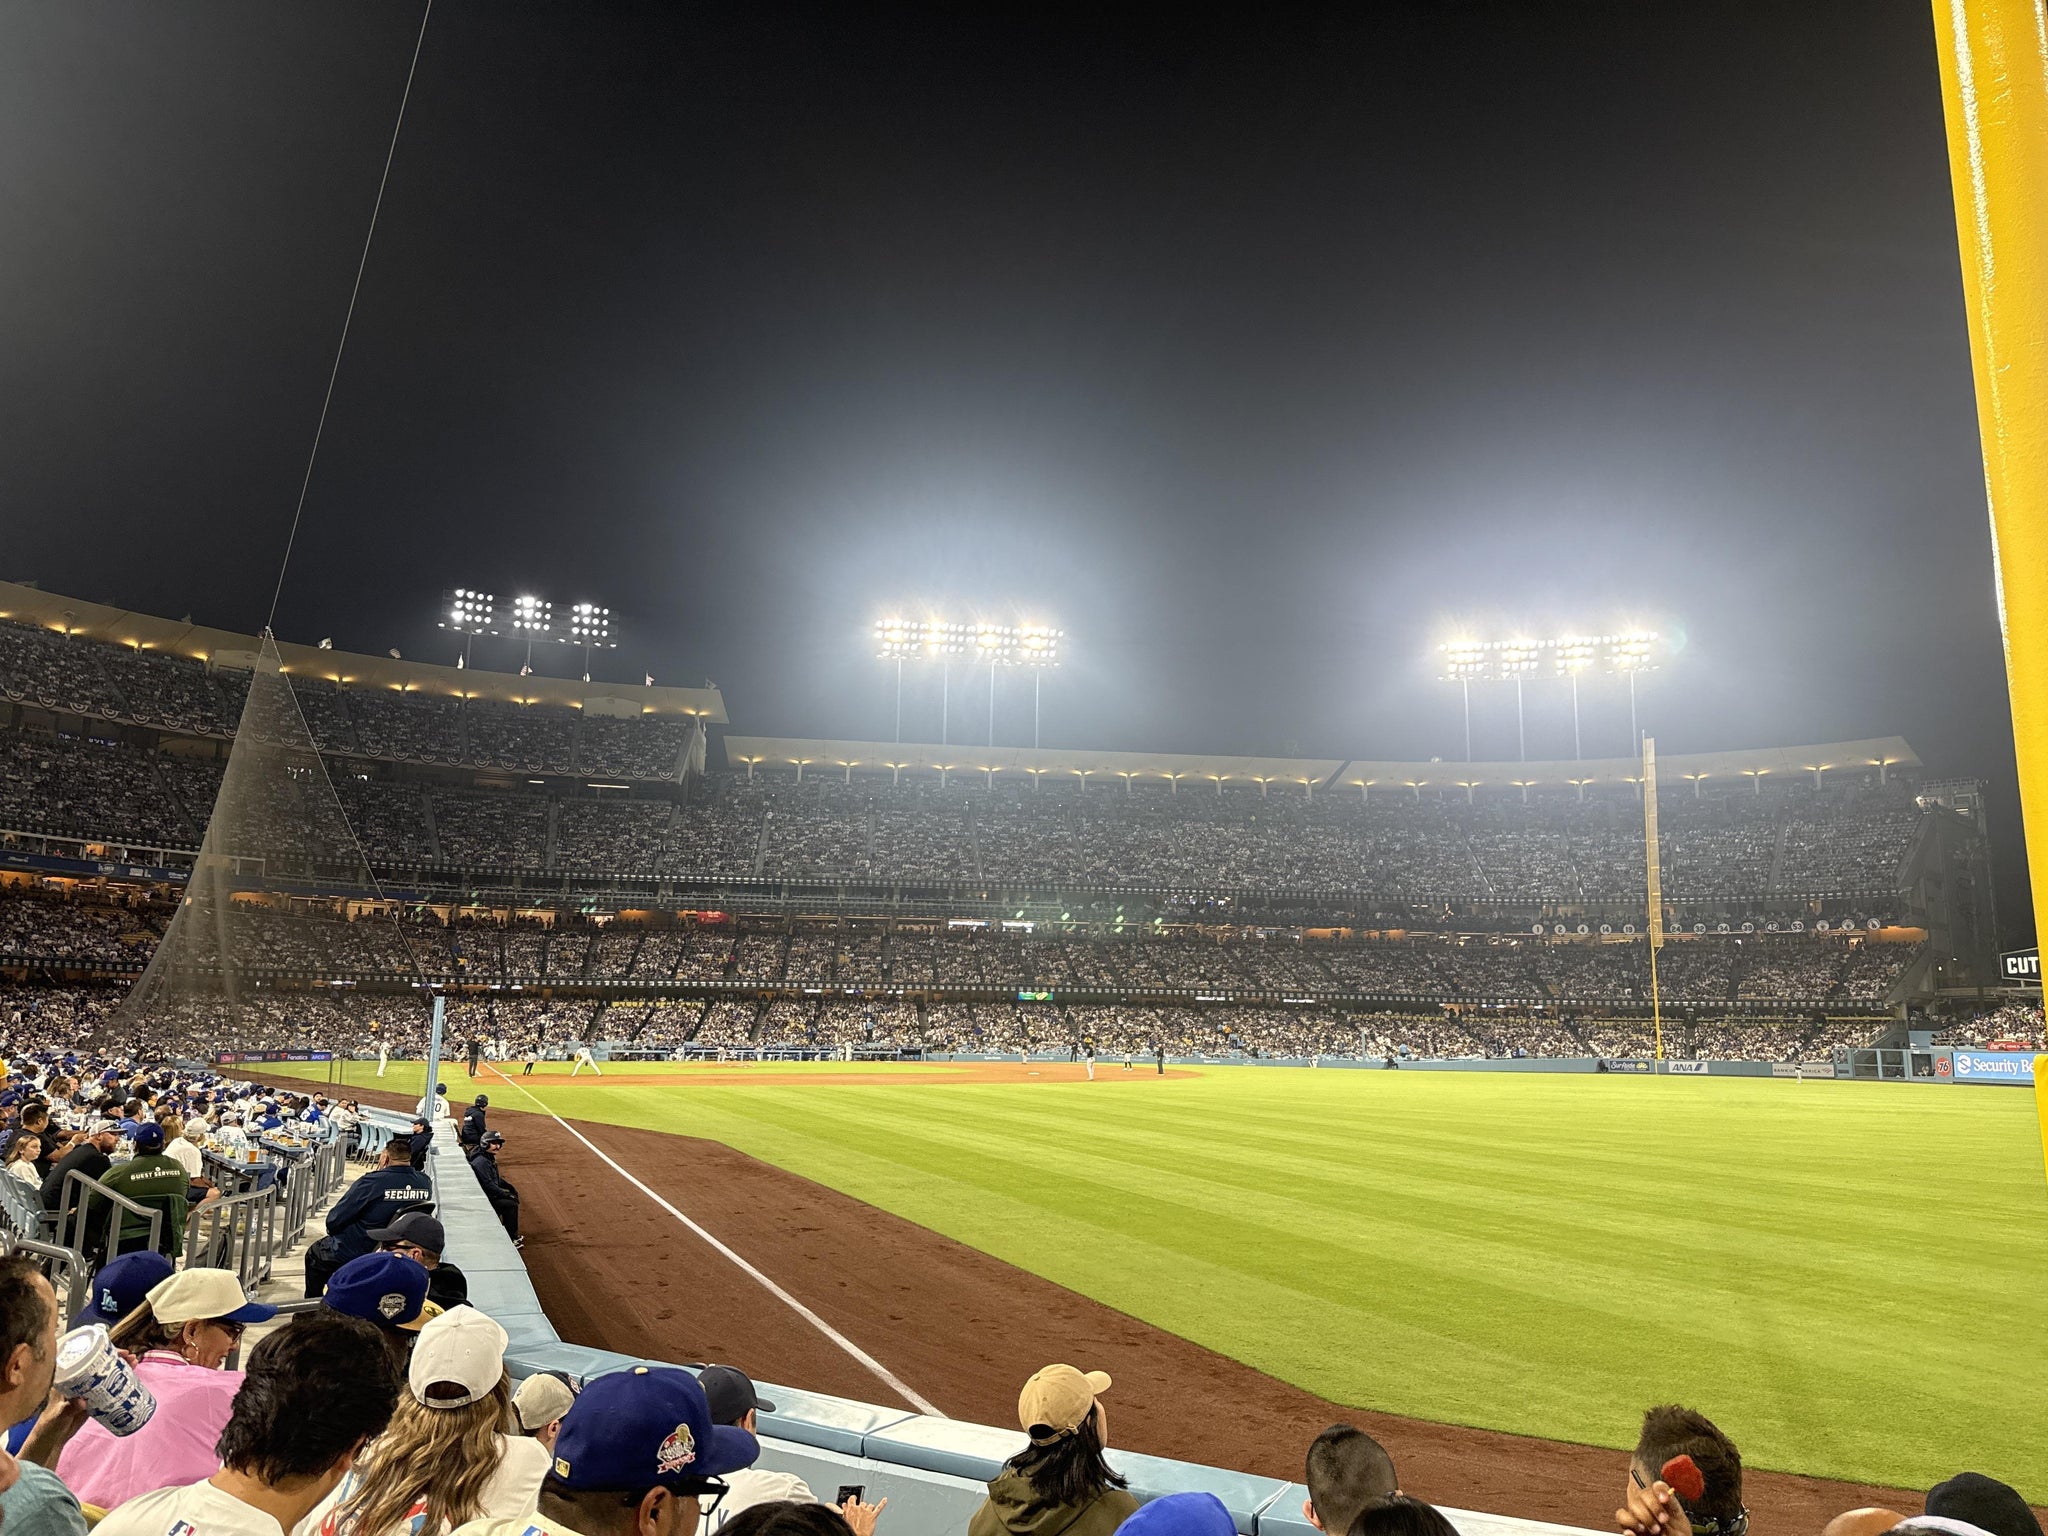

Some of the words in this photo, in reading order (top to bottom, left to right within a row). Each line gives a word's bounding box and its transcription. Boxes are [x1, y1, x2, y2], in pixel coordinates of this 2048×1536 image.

[1766, 923, 1777, 931] 42
[2007, 957, 2038, 974] CUT
[1672, 1063, 1693, 1071] ANA
[1938, 1061, 1949, 1072] 76
[1973, 1058, 2018, 1075] Security
[130, 1172, 153, 1180] GUEST
[384, 1190, 429, 1200] SECURITY
[101, 1288, 118, 1312] LA
